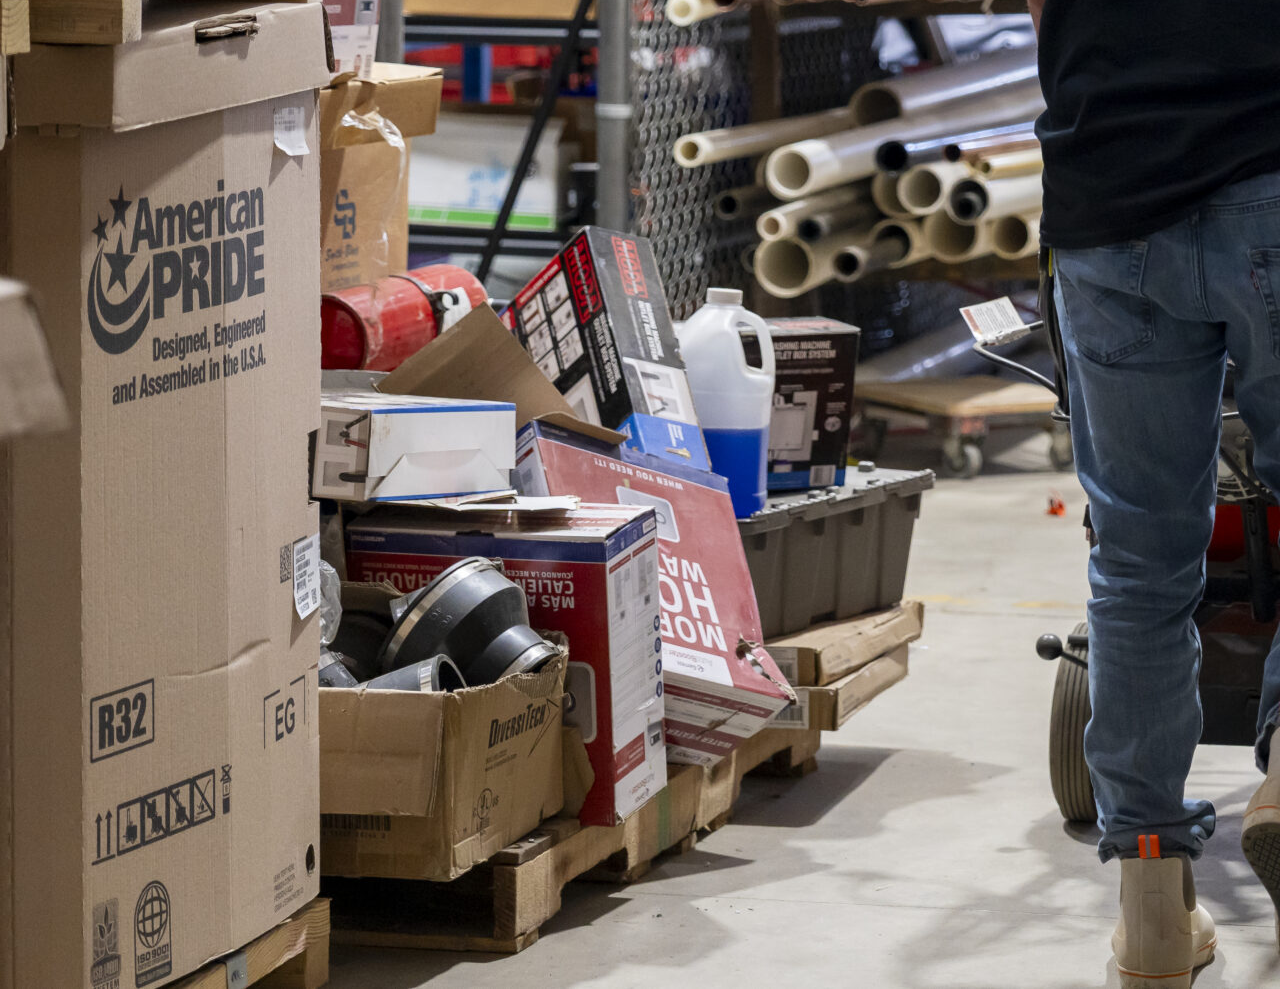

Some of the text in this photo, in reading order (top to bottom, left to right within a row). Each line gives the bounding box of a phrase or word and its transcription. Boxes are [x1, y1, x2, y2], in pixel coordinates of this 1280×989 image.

[130, 179, 264, 253] American
[152, 230, 265, 319] PRIDE
[153, 310, 266, 361] Designed, Engineered
[801, 340, 832, 350] MACHINE
[808, 349, 836, 359] SYSTEM
[112, 342, 266, 405] and Assembled in the U.S.A.
[609, 462, 633, 475] NEED
[635, 470, 653, 481] YOU
[656, 476, 683, 490] WHEN
[542, 594, 575, 612] MÁS
[99, 692, 147, 750] R32
[275, 697, 295, 742] EG
[137, 943, 169, 964] ISO 9001
